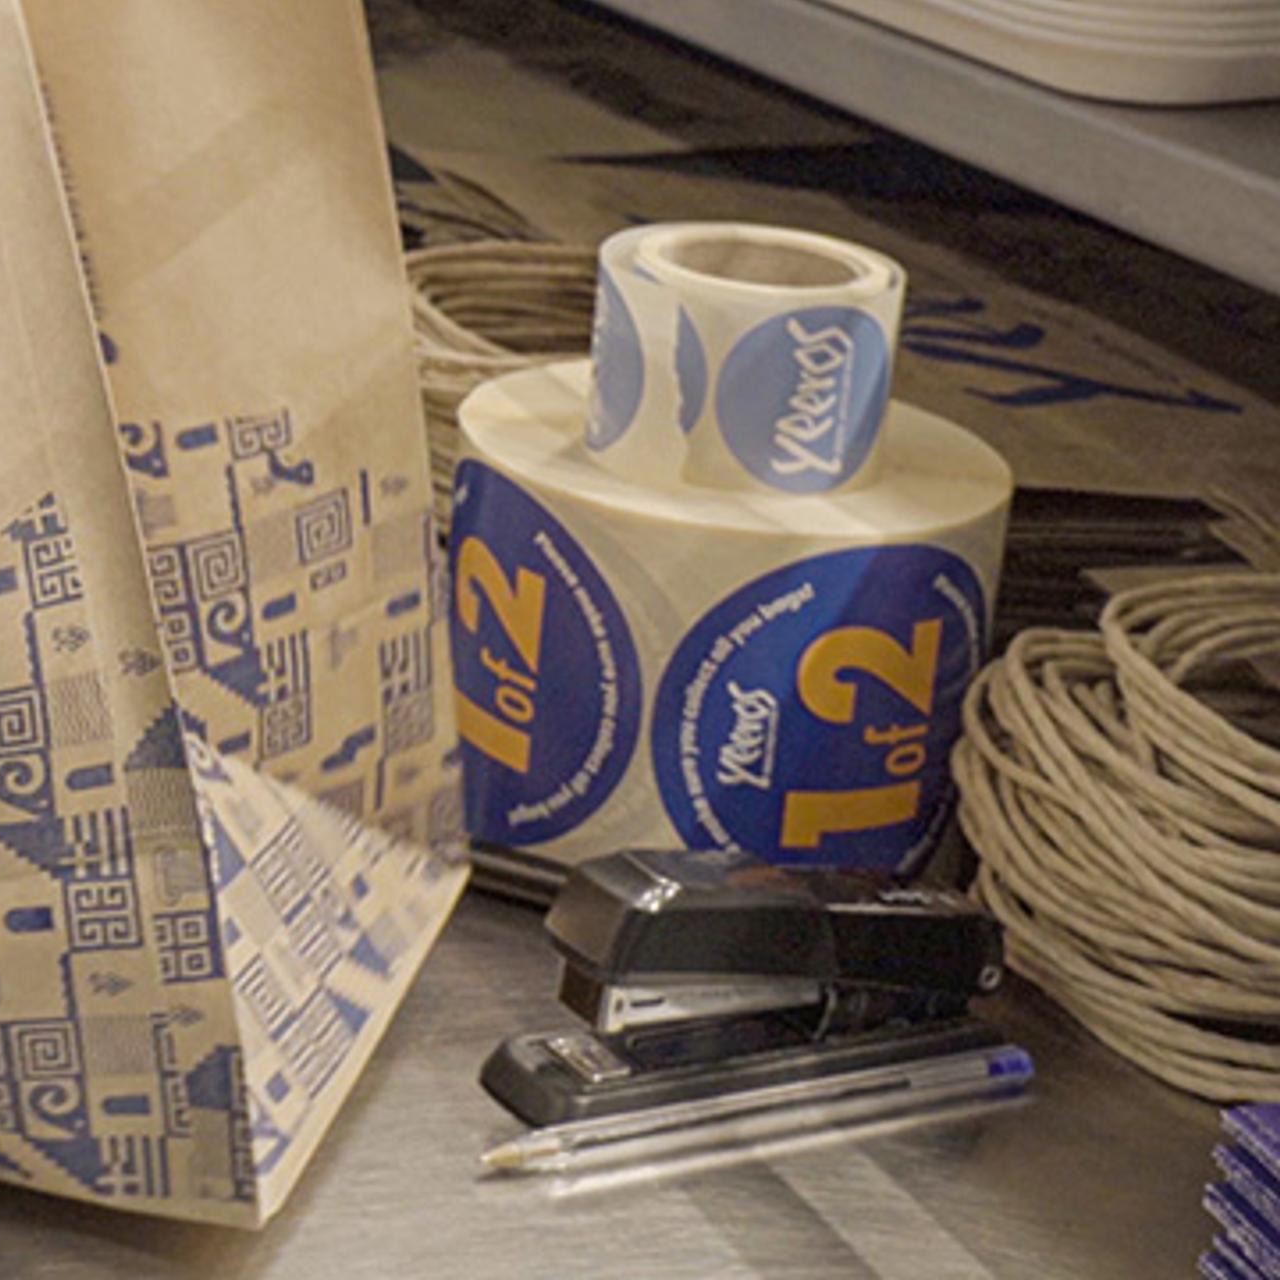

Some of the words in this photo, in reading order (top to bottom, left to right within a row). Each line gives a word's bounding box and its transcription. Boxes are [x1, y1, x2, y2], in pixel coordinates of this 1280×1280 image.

[455, 534, 547, 675] 2
[480, 646, 537, 724] of
[797, 617, 943, 725] 2
[454, 686, 531, 775] 1
[863, 723, 929, 775] of
[780, 779, 922, 848] 1
